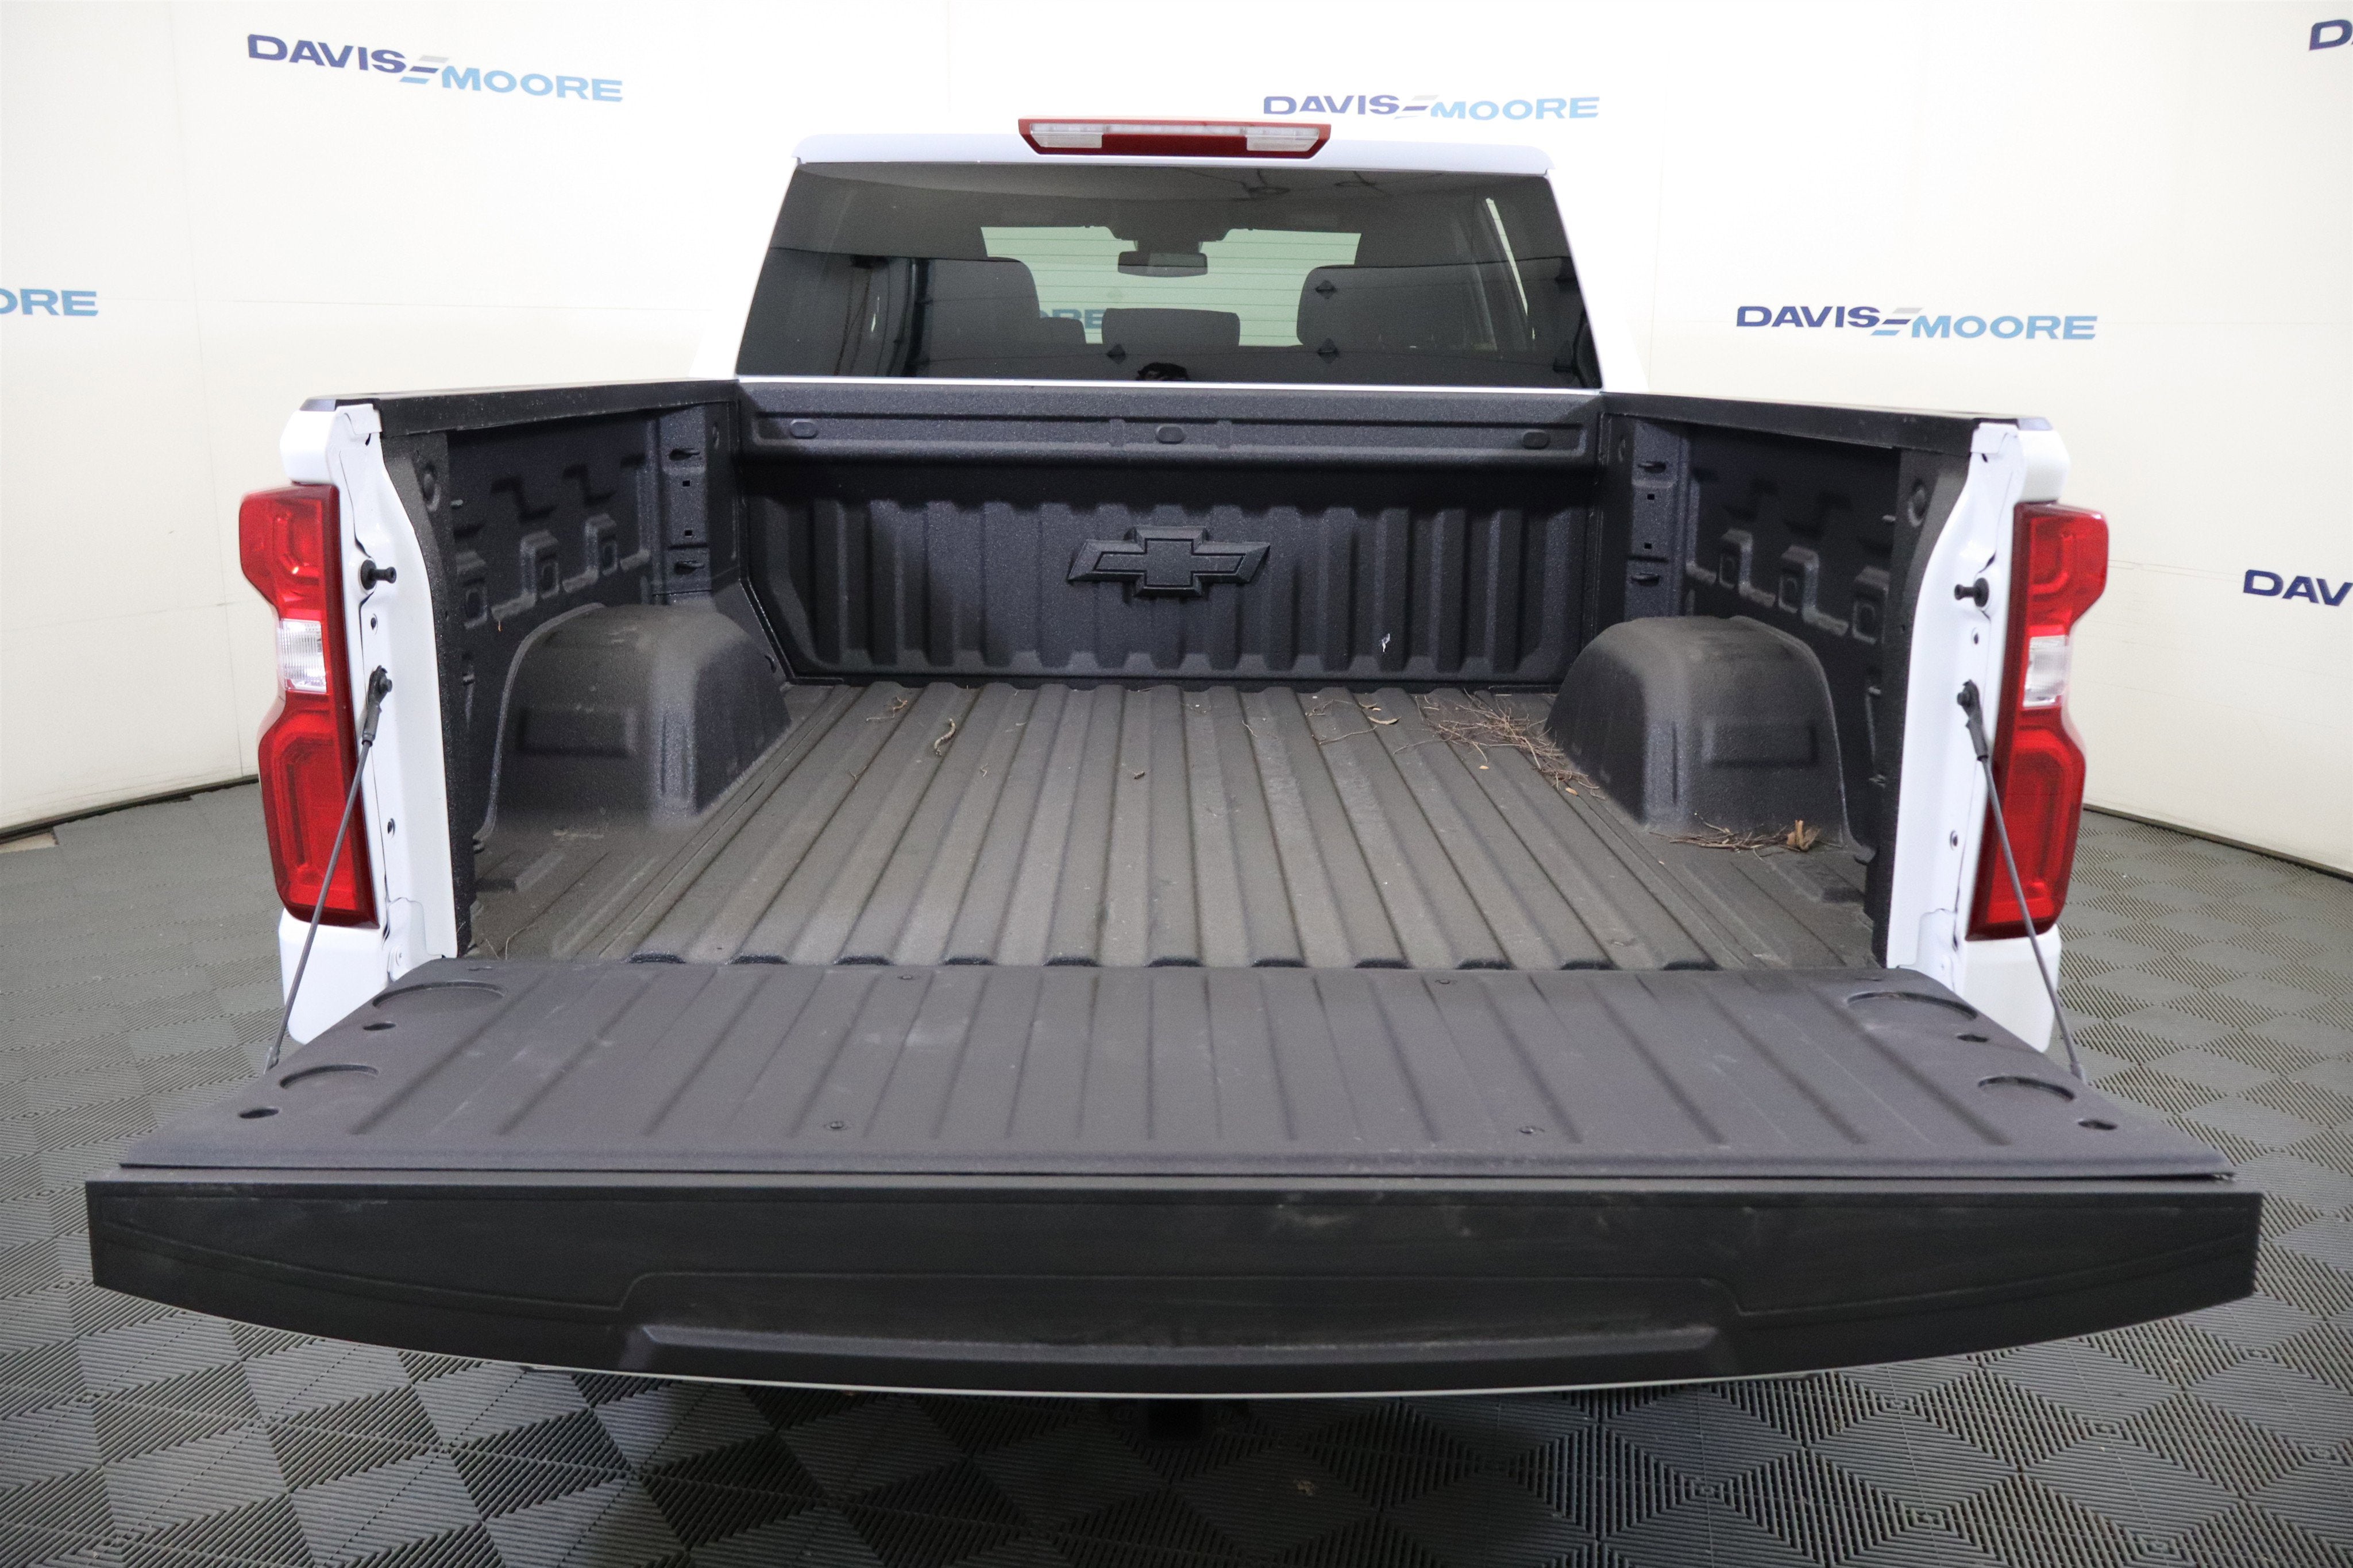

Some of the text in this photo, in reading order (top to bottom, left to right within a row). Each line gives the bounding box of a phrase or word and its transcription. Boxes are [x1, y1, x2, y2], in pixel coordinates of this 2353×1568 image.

[247, 33, 623, 102] DAVIS MOORE
[1263, 94, 1600, 121] DAVIS MOORE
[1736, 306, 2098, 340] DAVIS MOORE
